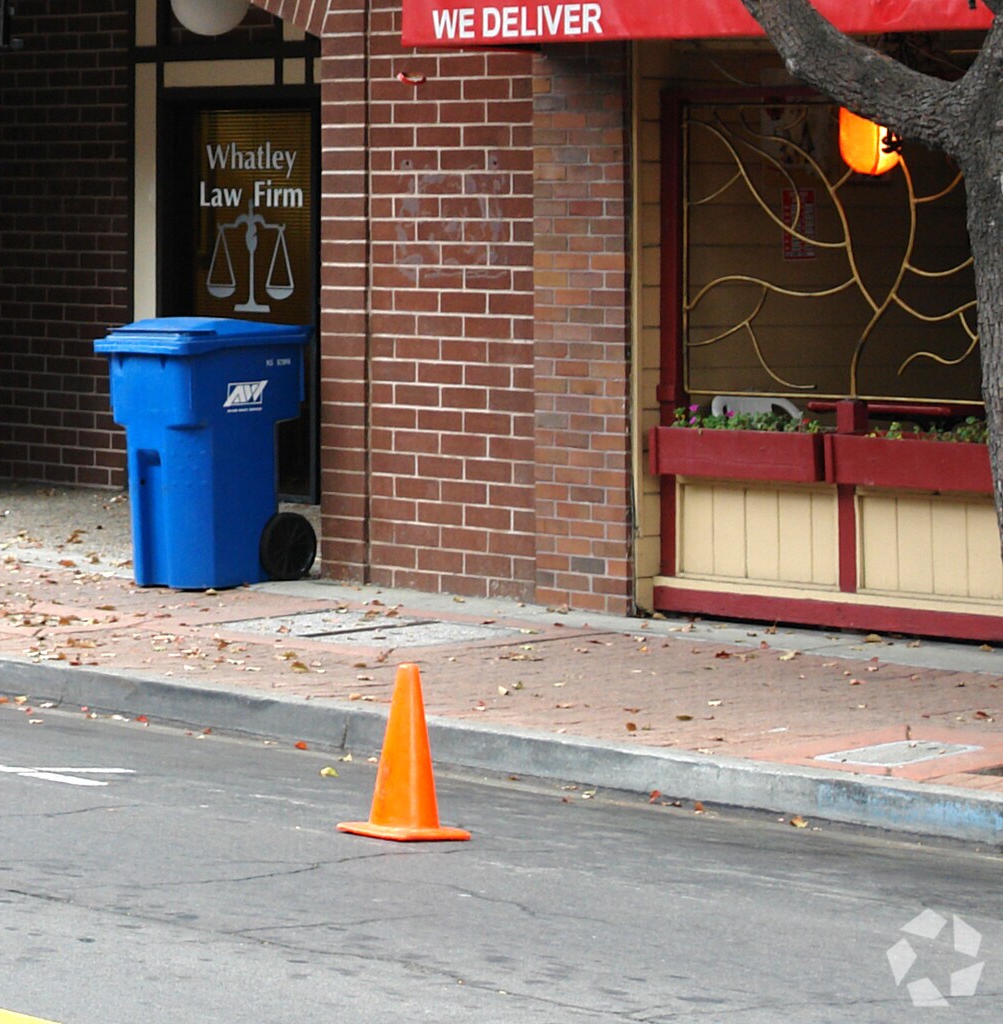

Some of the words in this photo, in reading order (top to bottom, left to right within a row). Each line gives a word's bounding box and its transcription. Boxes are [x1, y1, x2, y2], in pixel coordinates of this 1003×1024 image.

[432, 8, 475, 39] WE
[482, 3, 603, 37] DELIVER
[206, 141, 297, 180] Whatley
[199, 181, 243, 207] Law
[254, 179, 303, 207] Firm
